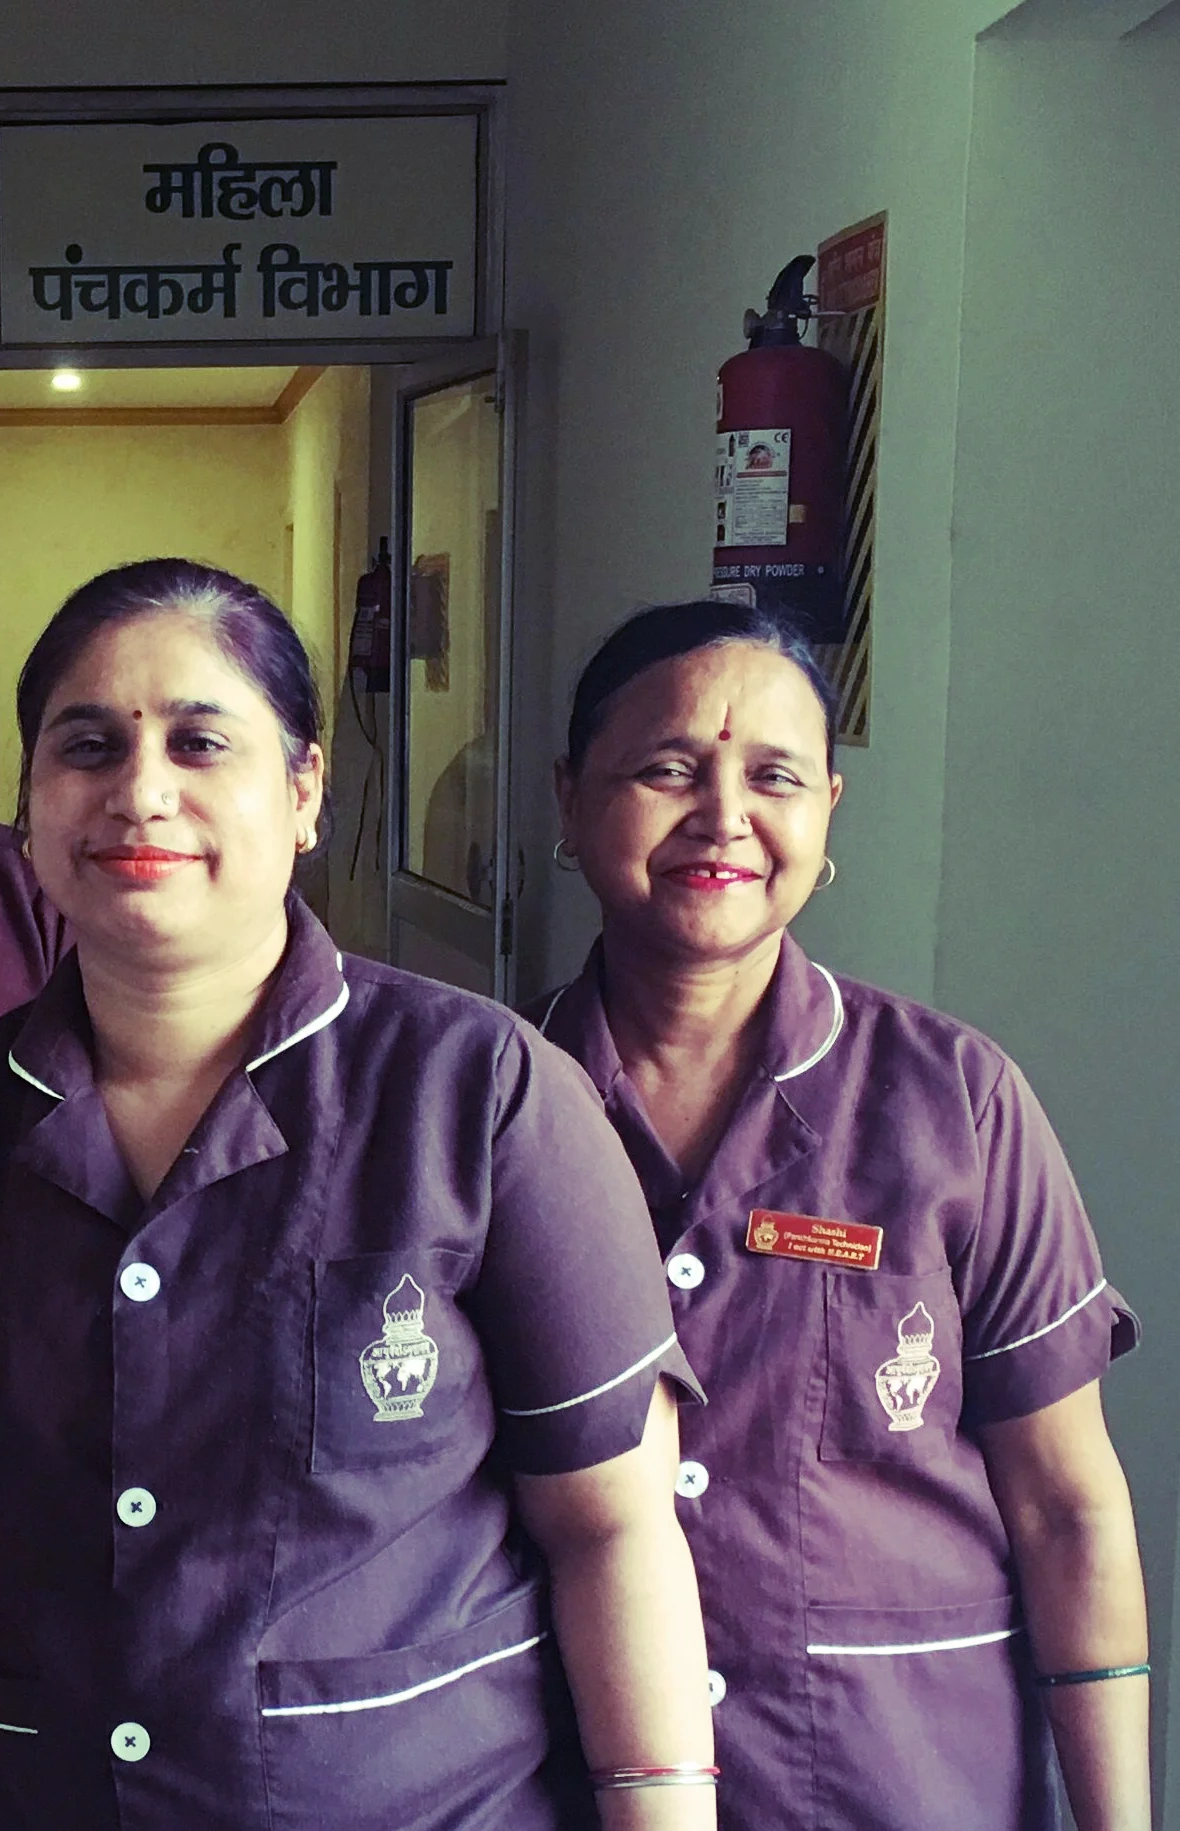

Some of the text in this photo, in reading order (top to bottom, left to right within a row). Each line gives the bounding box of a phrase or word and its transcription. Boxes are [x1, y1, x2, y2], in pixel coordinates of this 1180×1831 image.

[142, 142, 338, 220] महिला
[28, 242, 454, 320] पंचकर्म विभाग
[744, 565, 760, 577] DRY
[765, 564, 805, 576] POWDER
[811, 1224, 847, 1238] Shashi
